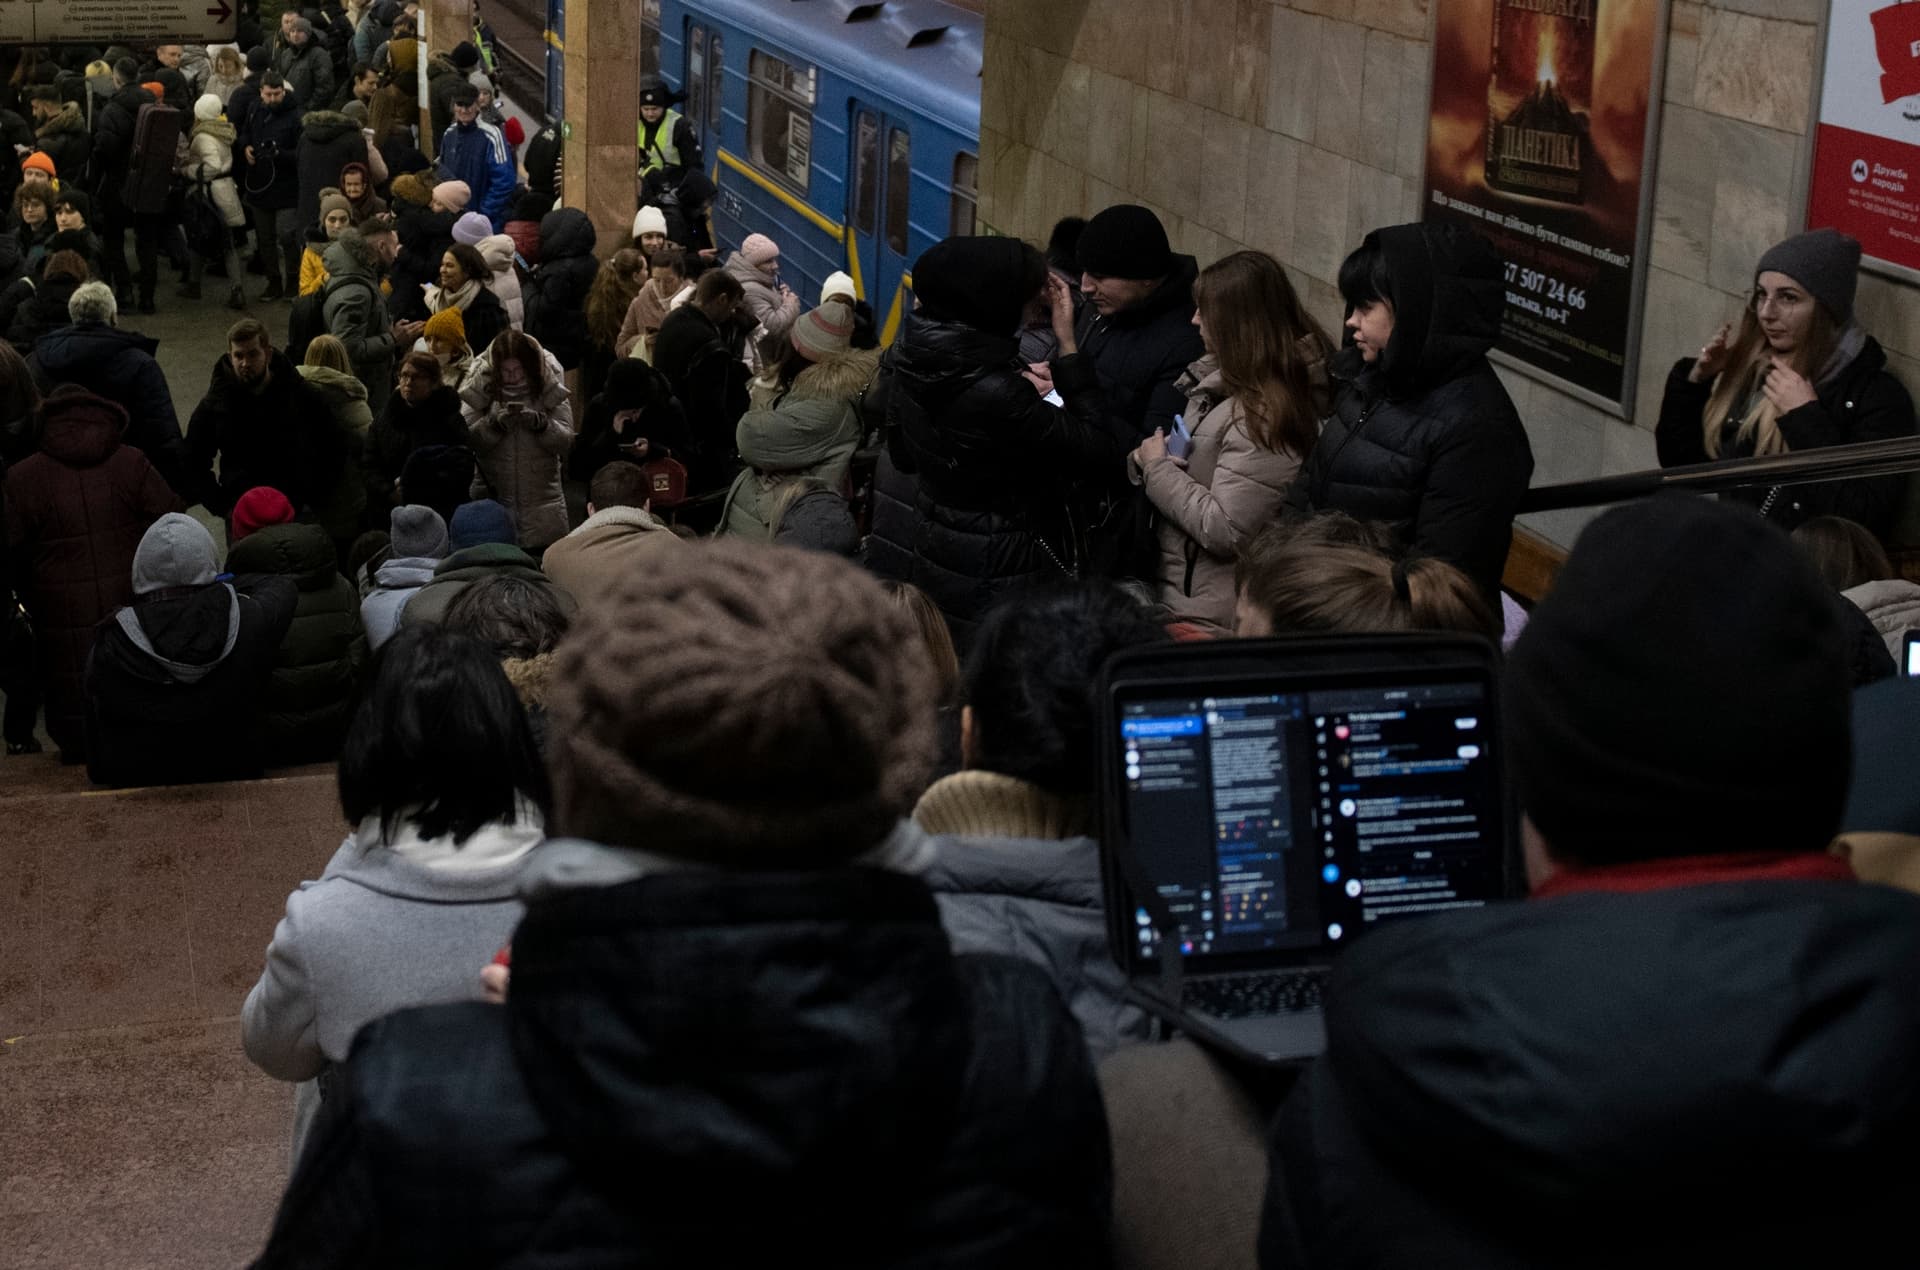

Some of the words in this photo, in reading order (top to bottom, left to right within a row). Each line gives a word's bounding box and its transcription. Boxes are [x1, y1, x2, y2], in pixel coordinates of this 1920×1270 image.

[1872, 177, 1905, 192] народів
[1873, 163, 1908, 180] Дружби
[1432, 190, 1448, 207] Що
[1485, 208, 1504, 224] вам
[1503, 213, 1535, 236] дійсно
[1536, 224, 1559, 243] бути
[1592, 247, 1631, 269] собою?
[1519, 268, 1546, 293] 507
[1547, 278, 1566, 303] 24
[1567, 287, 1587, 311] 66
